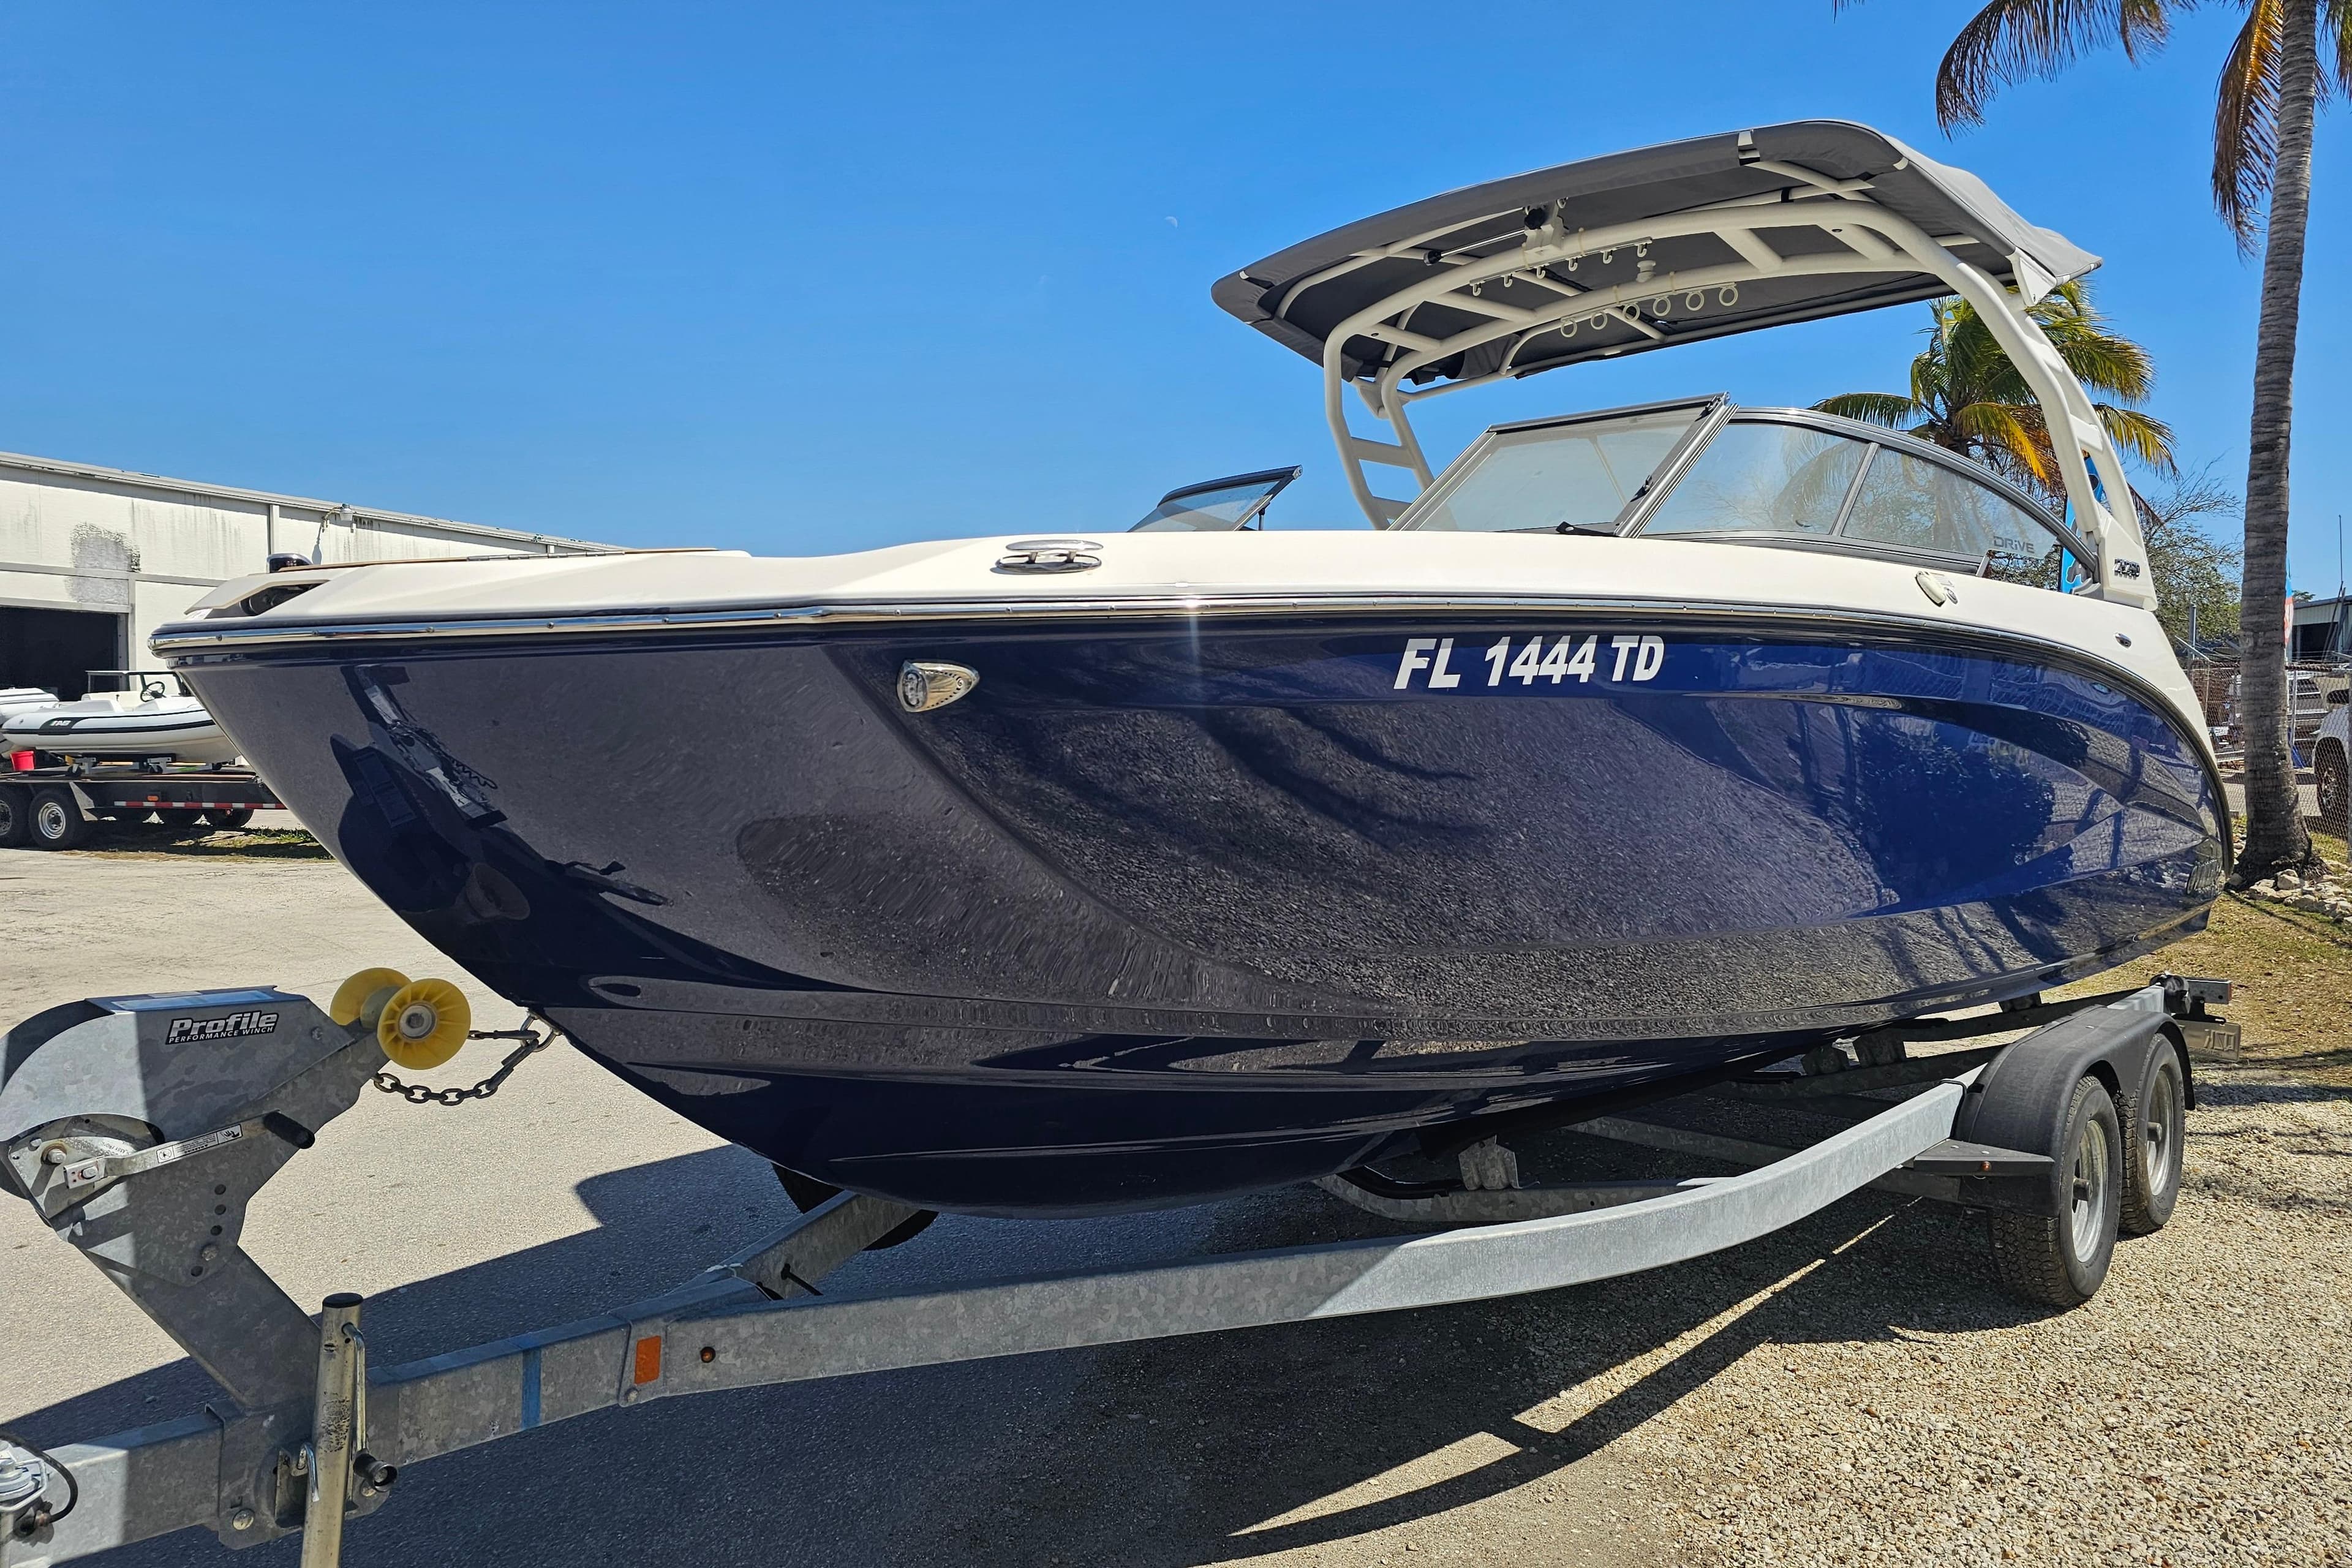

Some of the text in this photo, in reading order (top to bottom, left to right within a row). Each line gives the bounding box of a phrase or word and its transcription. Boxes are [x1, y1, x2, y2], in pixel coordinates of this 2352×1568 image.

[1393, 635, 1665, 690] FL 1444 TD
[168, 1026, 273, 1044] PERFORMANCE WINCH
[169, 1011, 277, 1038] Profile
